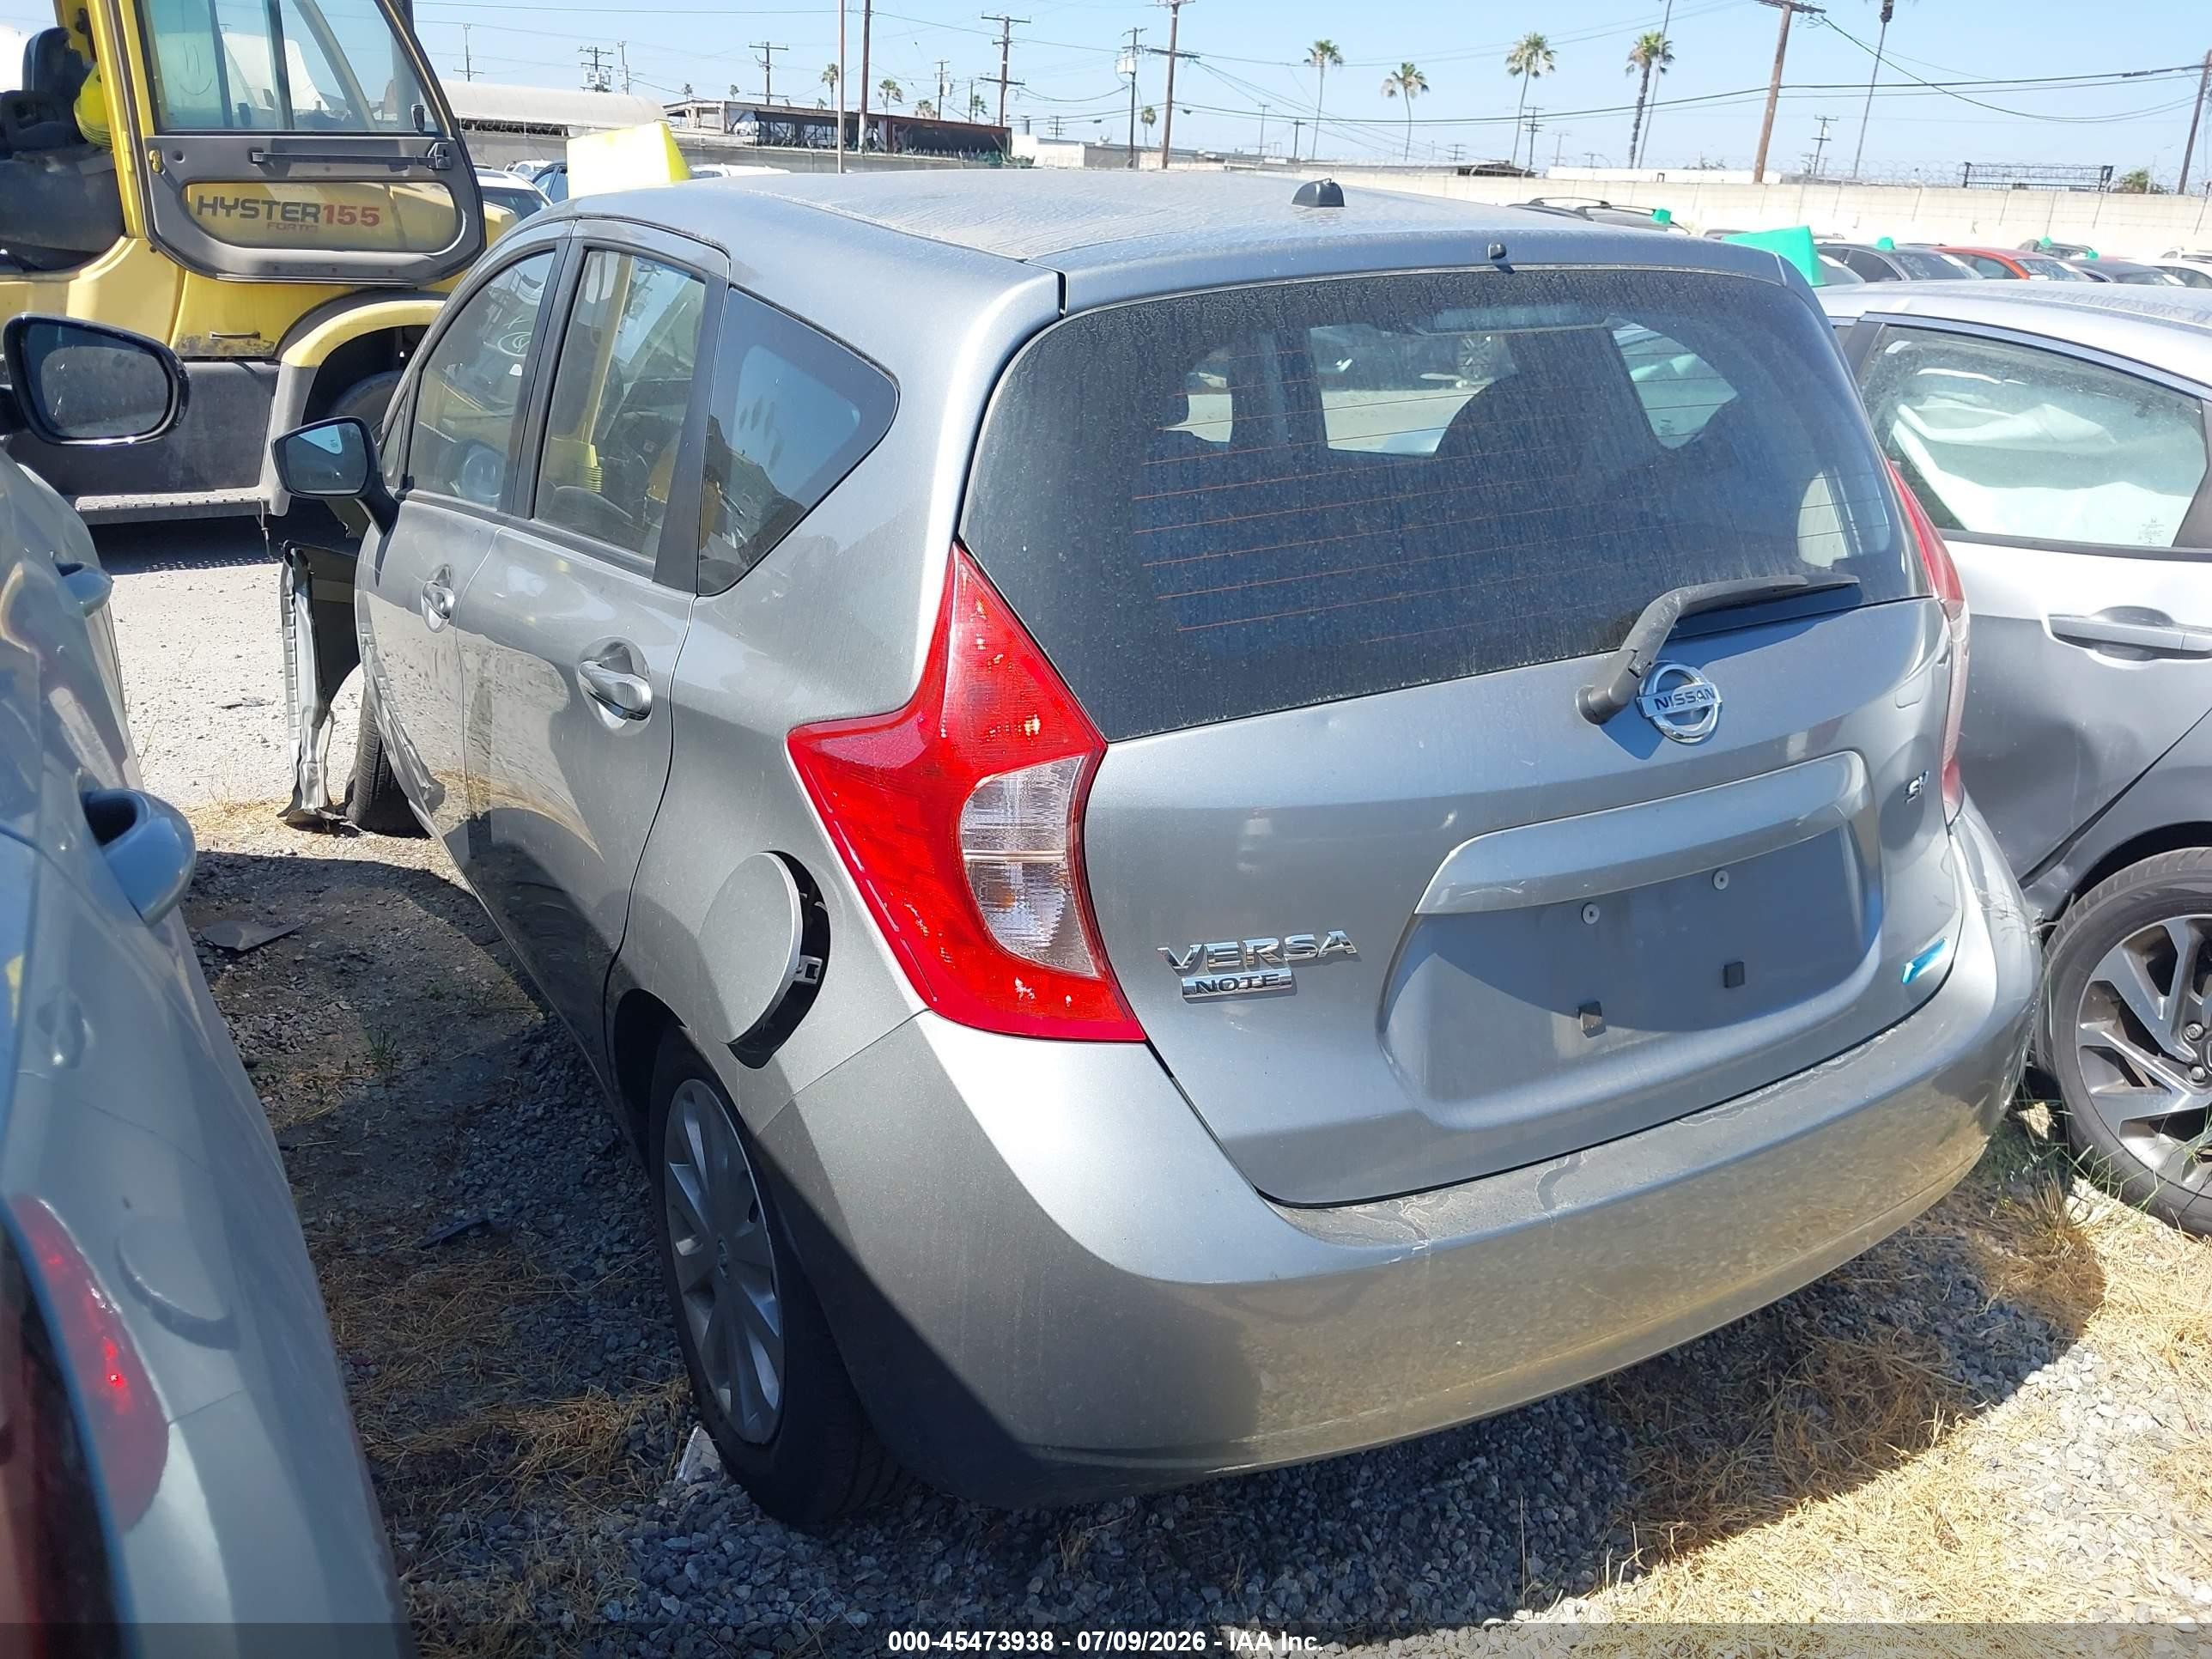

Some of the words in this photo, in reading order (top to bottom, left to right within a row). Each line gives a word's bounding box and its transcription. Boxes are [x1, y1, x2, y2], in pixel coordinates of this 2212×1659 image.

[197, 195, 319, 223] HYSTER
[323, 204, 380, 227] 155
[1653, 687, 1716, 711] NISSAN
[1157, 930, 1358, 970] VERSA
[1194, 973, 1280, 994] NOTE
